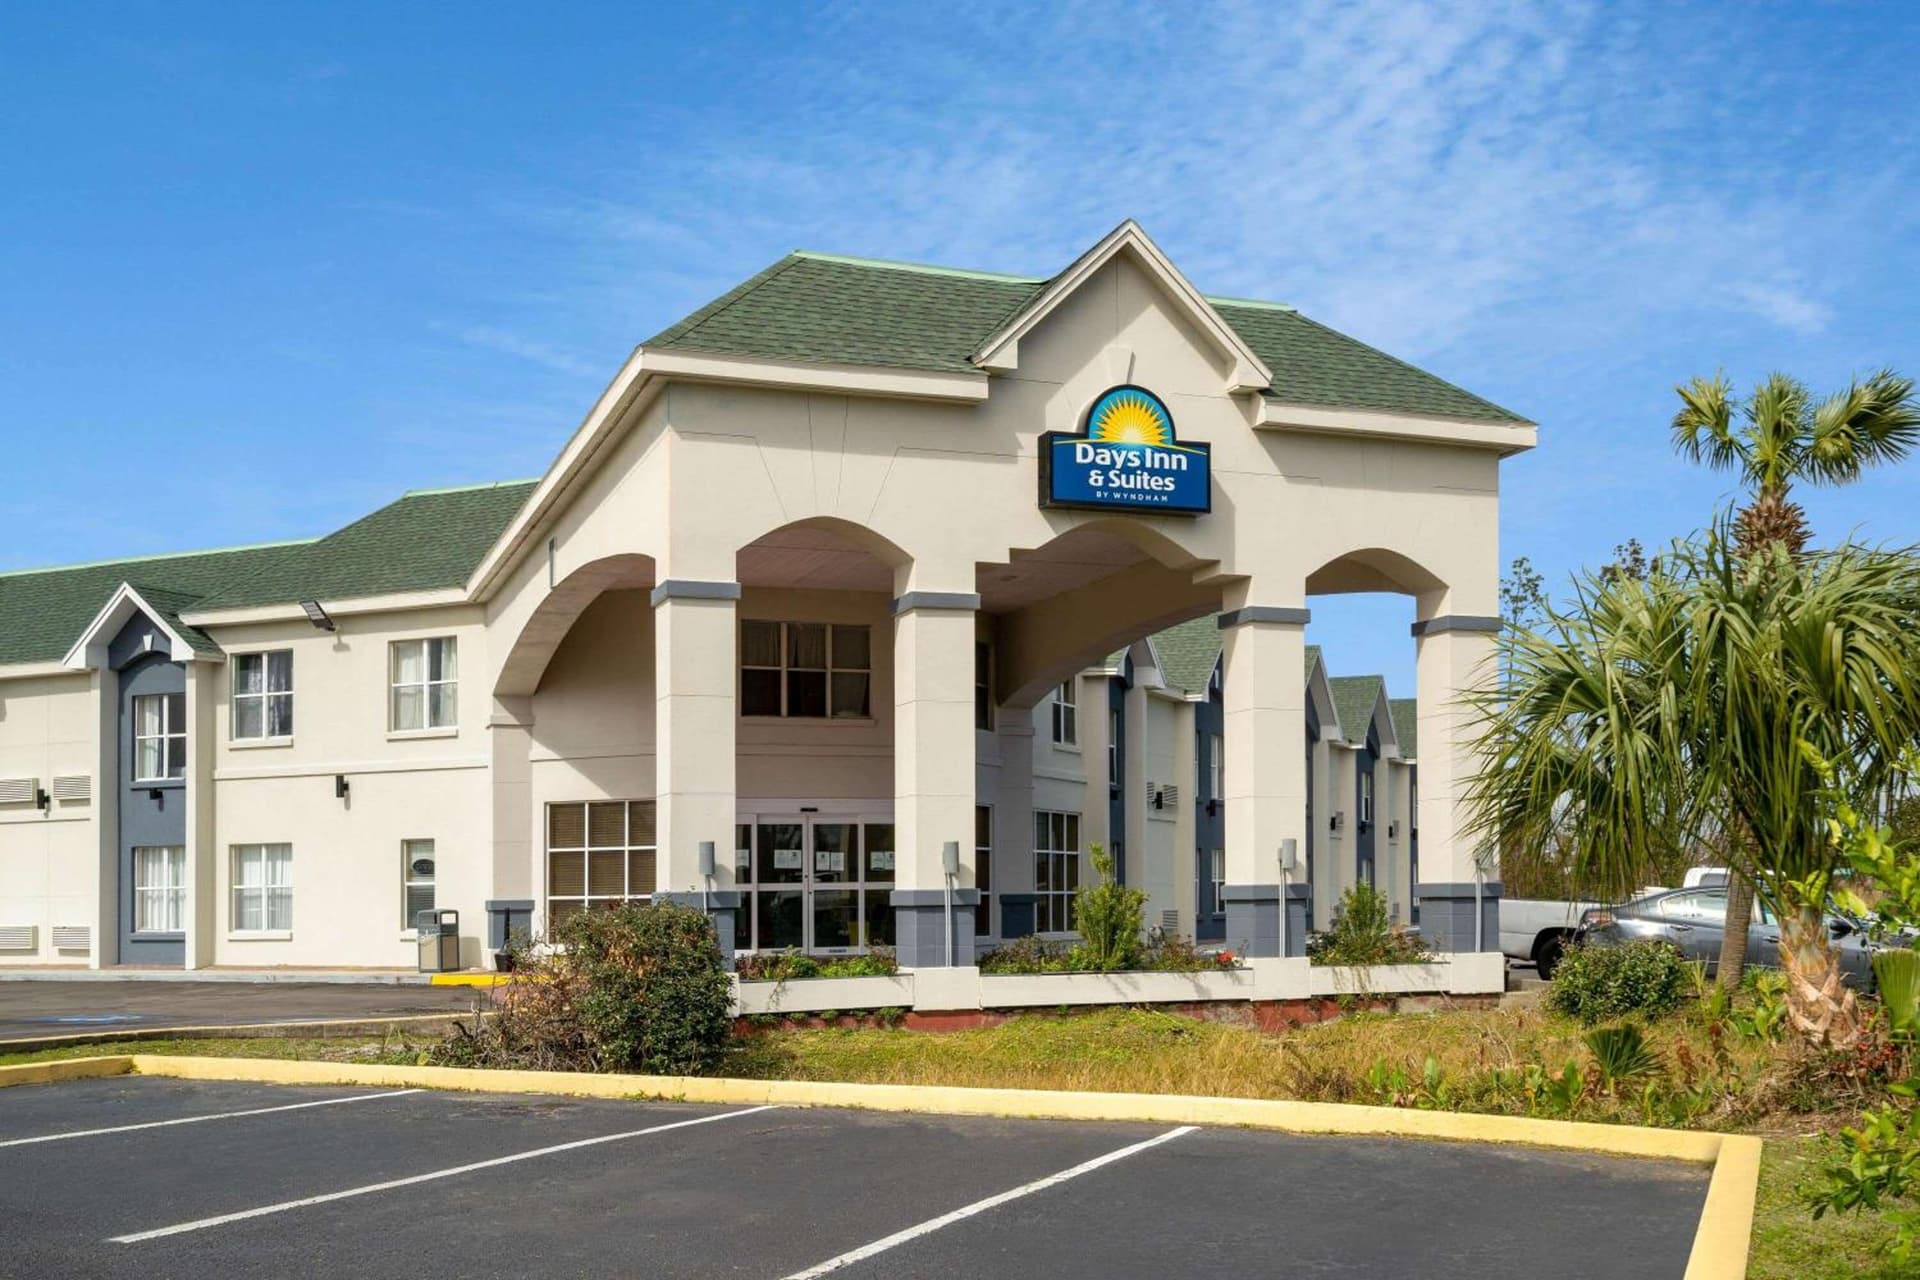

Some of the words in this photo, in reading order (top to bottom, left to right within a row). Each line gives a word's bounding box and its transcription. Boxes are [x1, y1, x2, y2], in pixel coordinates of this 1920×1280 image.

[1075, 443, 1141, 469] Days
[1145, 448, 1188, 471] Inn
[1088, 469, 1104, 487] &
[1108, 470, 1176, 491] Suites
[1096, 491, 1109, 499] BY
[1113, 491, 1169, 502] WYNDHAM
